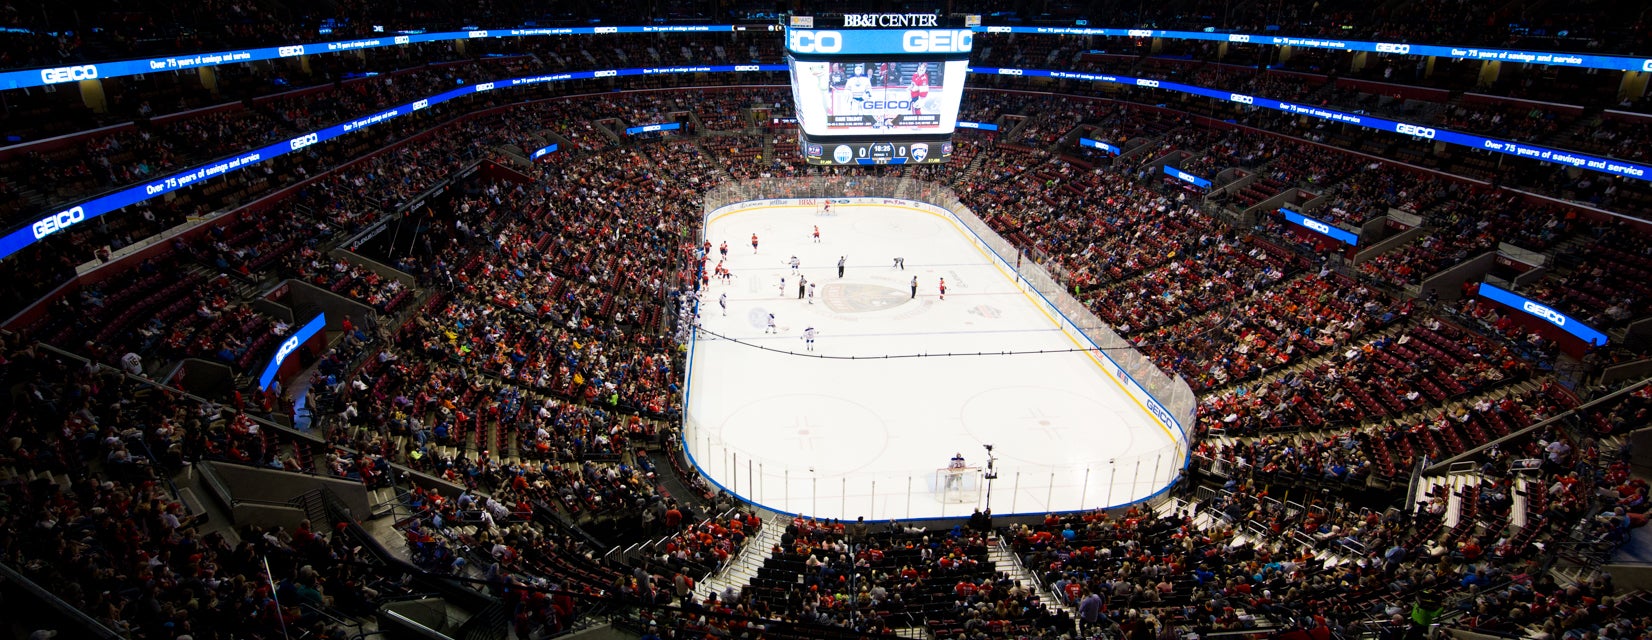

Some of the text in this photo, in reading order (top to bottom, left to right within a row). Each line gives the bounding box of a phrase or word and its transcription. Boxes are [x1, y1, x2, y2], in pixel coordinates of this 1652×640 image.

[843, 14, 938, 27] BB&T CENTER
[1229, 34, 1249, 42] GEICO
[279, 45, 304, 57] GEICO
[1376, 43, 1410, 54] GEICO
[1452, 49, 1466, 57] Over
[1479, 52, 1497, 60] years
[1508, 53, 1535, 62] savings
[1554, 56, 1582, 64] service
[41, 65, 97, 84] GEICO
[863, 100, 909, 110] GEICO
[1231, 94, 1253, 104] GEICO
[1396, 123, 1435, 138] GEICO
[290, 133, 317, 150] GEICO
[1485, 140, 1502, 149] Over
[1505, 144, 1515, 152] 75
[1518, 148, 1539, 156] years
[1553, 154, 1585, 166] savings
[1608, 165, 1643, 176] service
[147, 154, 259, 194] Over 75 years of savings and service
[33, 206, 84, 239] GEICO
[1304, 219, 1328, 233] GEICO
[1524, 302, 1565, 325] GEICO
[1147, 399, 1173, 430] GEICO
